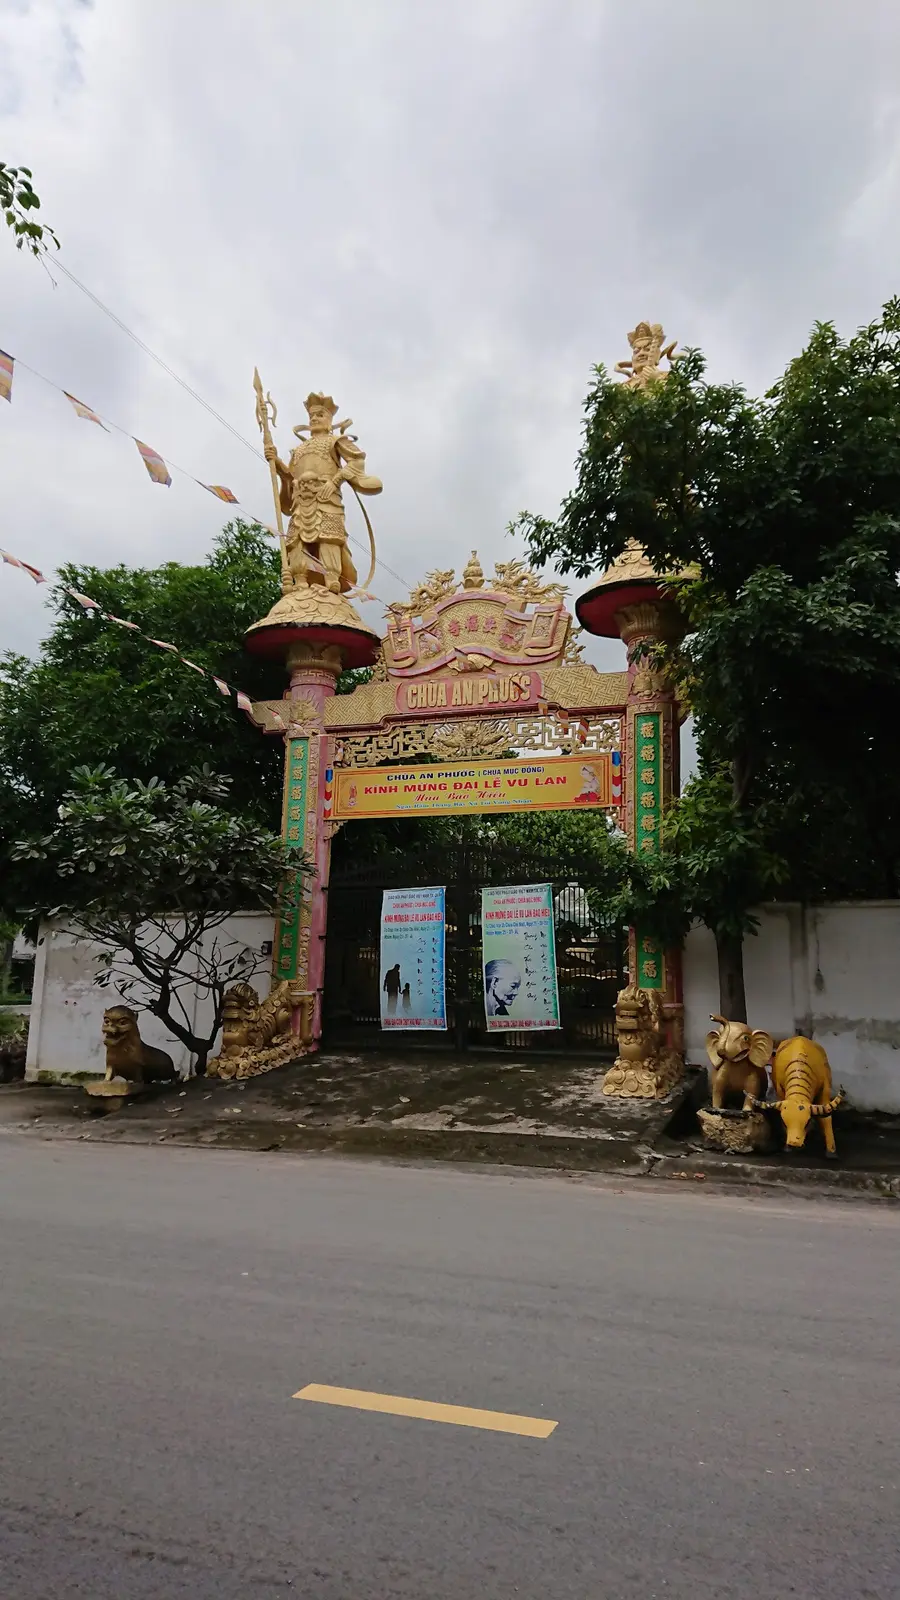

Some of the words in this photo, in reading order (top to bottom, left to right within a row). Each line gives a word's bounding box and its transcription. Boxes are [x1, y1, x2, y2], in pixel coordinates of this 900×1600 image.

[407, 679, 447, 709] CHÙA
[452, 680, 475, 707] AN
[386, 773, 416, 782] CHÙA
[437, 770, 475, 779] PHƯỚC
[403, 782, 448, 793] MỪNG
[453, 781, 478, 791] ĐẠI
[484, 776, 501, 789] LỄ
[507, 778, 528, 787] VU
[535, 776, 567, 786] LAN
